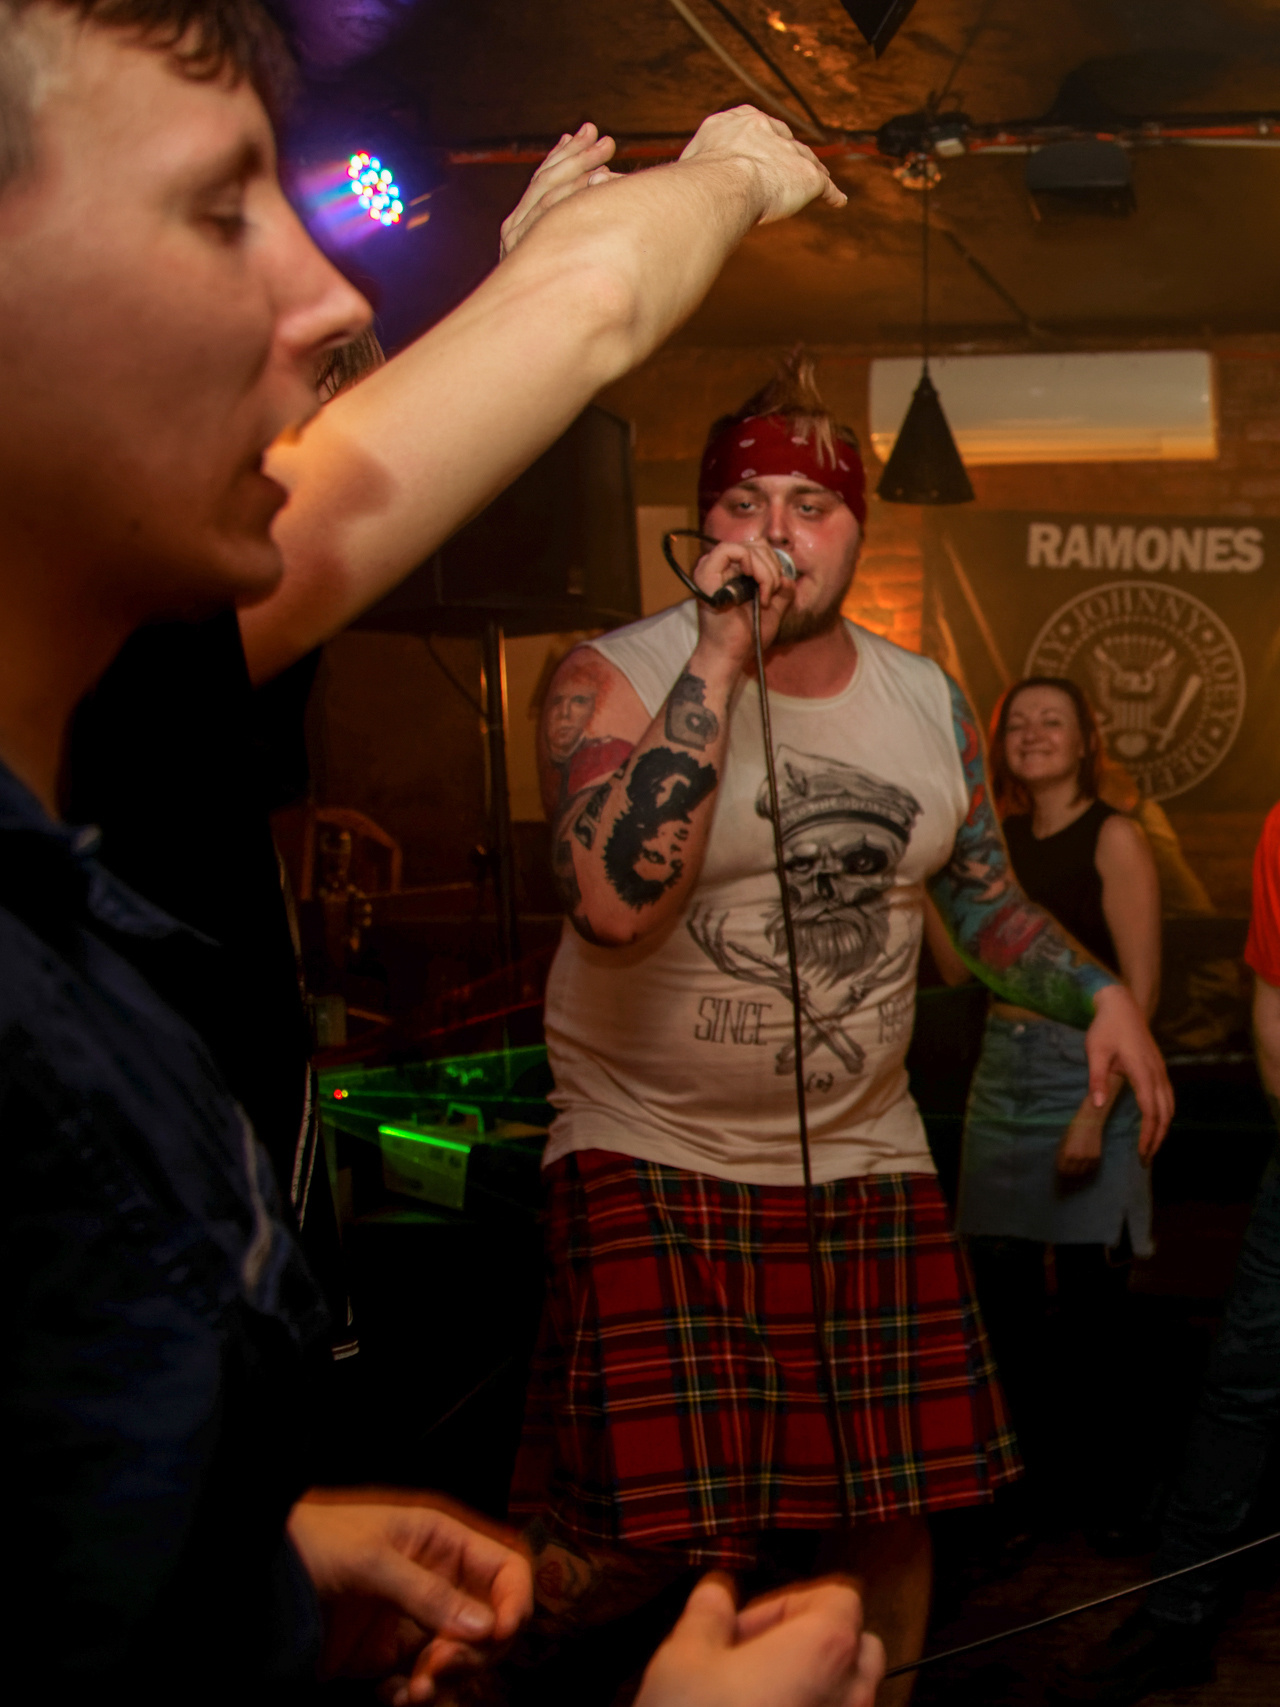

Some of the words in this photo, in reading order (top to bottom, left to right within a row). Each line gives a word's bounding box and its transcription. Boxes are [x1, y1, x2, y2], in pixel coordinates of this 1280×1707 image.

[1026, 522, 1265, 574] RAMONES
[1071, 588, 1202, 634] JOHNNY
[1203, 642, 1239, 724] JOEY
[694, 996, 772, 1046] SINCE
